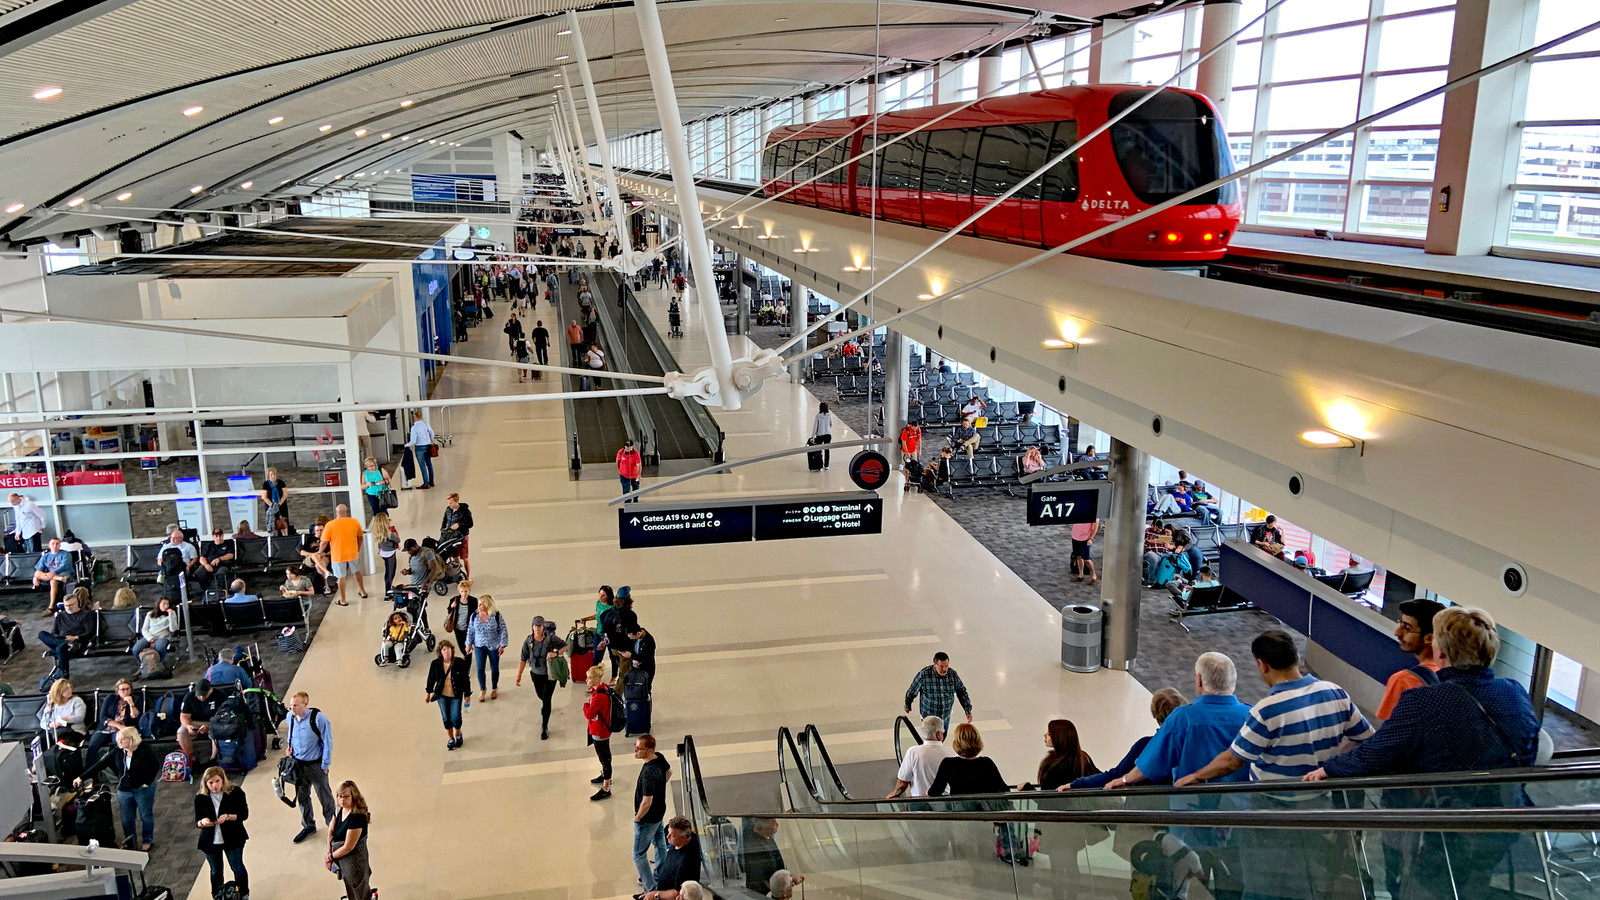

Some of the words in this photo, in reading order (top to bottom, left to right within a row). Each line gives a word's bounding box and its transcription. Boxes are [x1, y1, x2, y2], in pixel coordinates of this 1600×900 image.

[1091, 199, 1129, 209] DELTA
[831, 503, 861, 512] Terminal
[1040, 502, 1075, 518] A17
[642, 515, 664, 523] Gates
[690, 512, 705, 520] A78
[810, 514, 840, 523] Luggage
[841, 512, 861, 520] Claim
[642, 522, 684, 531] Concourses
[685, 521, 691, 529] B
[691, 520, 706, 528] and
[841, 520, 861, 528] Hotel
